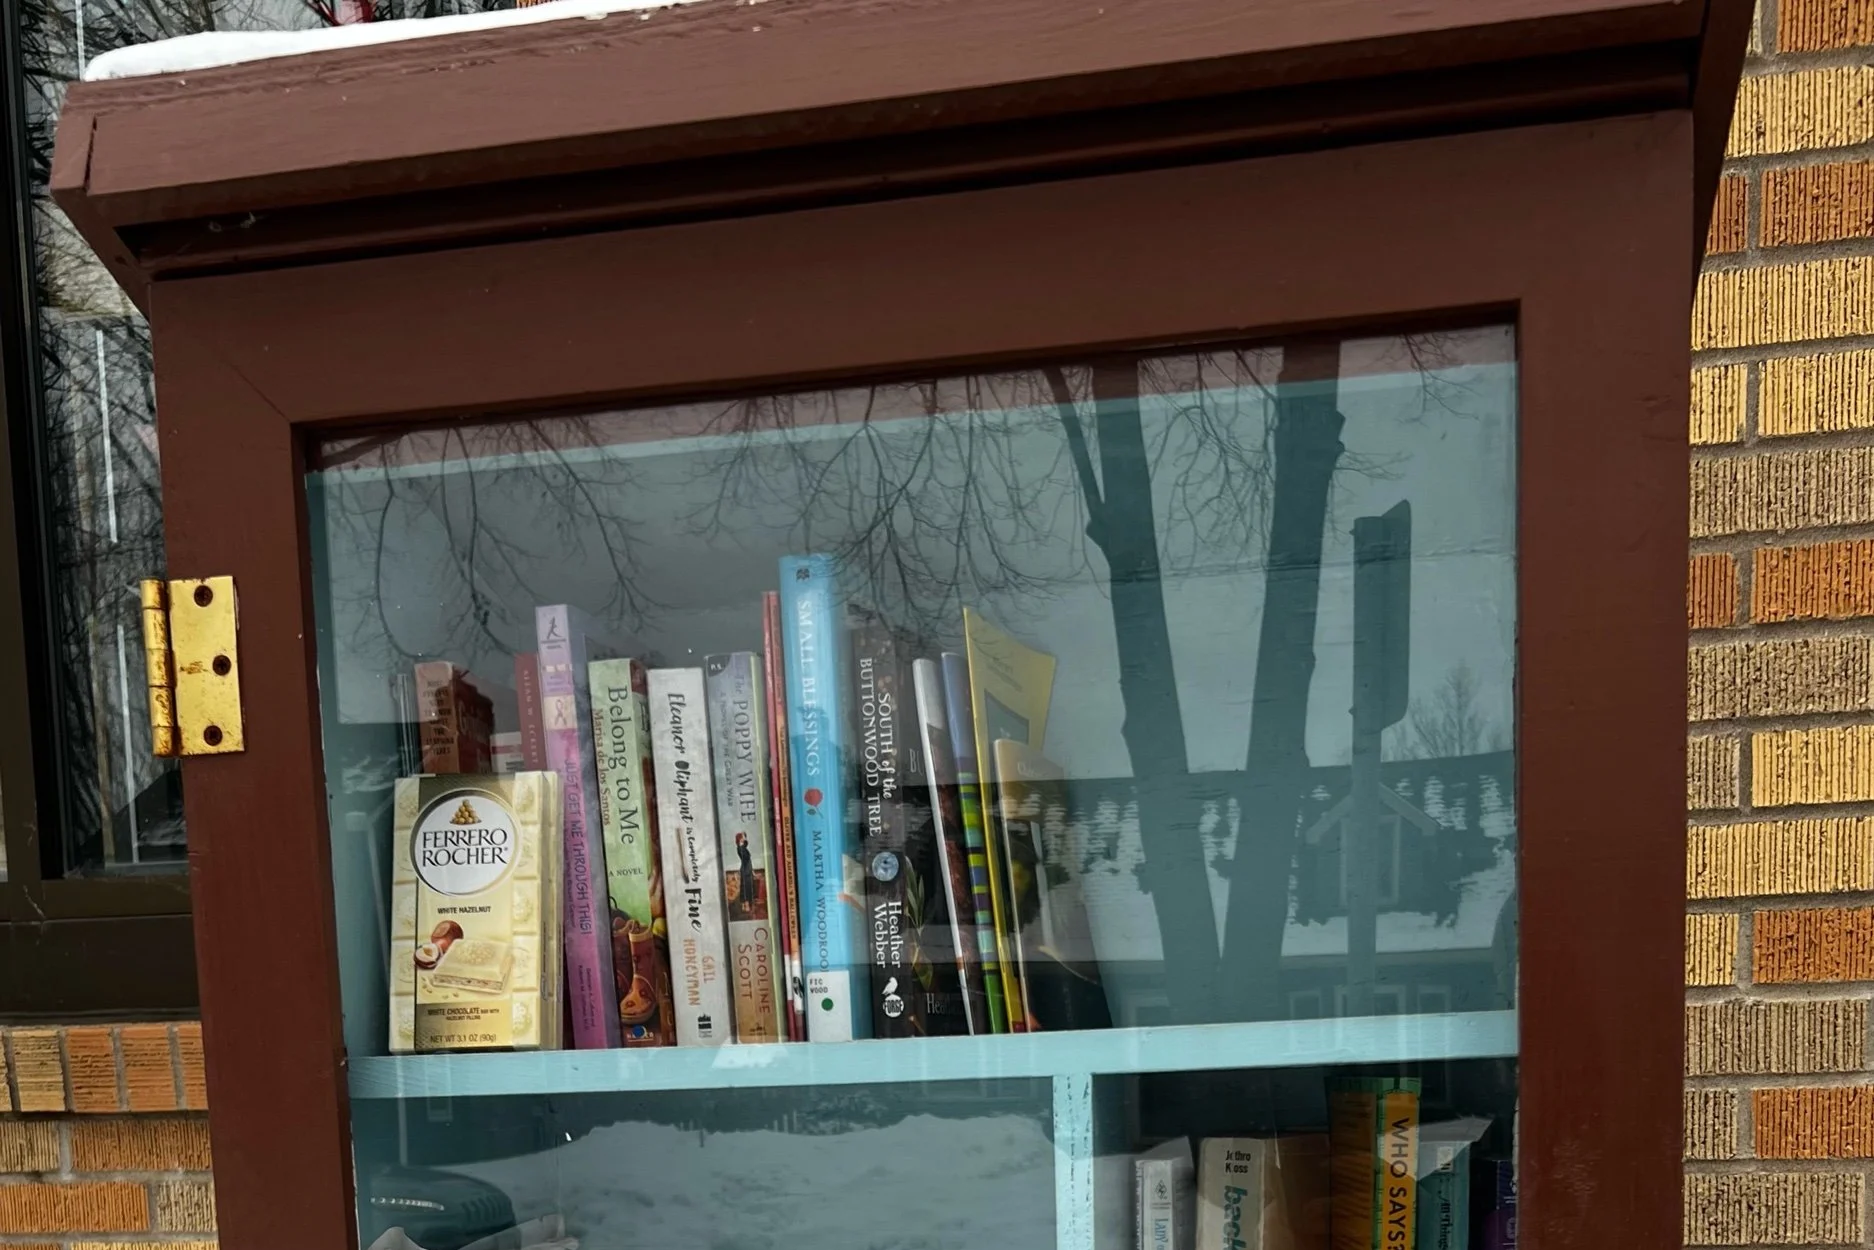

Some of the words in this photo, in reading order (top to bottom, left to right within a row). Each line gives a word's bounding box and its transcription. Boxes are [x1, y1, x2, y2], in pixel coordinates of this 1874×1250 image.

[798, 599, 814, 675] SMALL
[593, 708, 606, 751] Marisa
[607, 686, 632, 770] Belong
[667, 692, 687, 754] Eleanor
[733, 700, 753, 763] POPPY
[802, 677, 820, 777] BLESSINGS
[859, 657, 880, 787] BUTTONWOOD
[878, 691, 893, 755] SOUTH
[565, 759, 579, 790] JUST
[597, 751, 608, 765] de
[599, 768, 609, 785] los
[882, 760, 896, 774] of
[568, 793, 582, 817] GET
[601, 787, 611, 826] Santos
[616, 776, 631, 801] to
[673, 760, 694, 824] Oliphant
[736, 771, 757, 823] WIFE
[882, 777, 897, 800] the
[570, 820, 584, 839] ME
[618, 807, 640, 845] Me
[686, 827, 693, 835] is
[867, 792, 882, 837] TREE
[422, 828, 508, 849] FERRERO
[422, 847, 508, 868] ROCHER
[573, 842, 589, 901] THROUGH
[608, 869, 614, 877] A
[616, 868, 643, 877] NOVEL
[812, 830, 825, 892] MARTHA
[437, 906, 458, 915] WHITE
[459, 905, 492, 914] HAZELNUT
[684, 888, 702, 934] Fine
[817, 897, 830, 972] WOODROO
[874, 902, 889, 969] Webber
[888, 901, 904, 969] Heather
[683, 938, 701, 1007] HONEYMAN
[701, 955, 716, 984] GAIL
[738, 943, 752, 1000] SCOTT
[753, 927, 771, 1014] CAROLINE
[809, 978, 823, 986] FIC
[809, 986, 829, 994] WOOD
[430, 1035, 443, 1043] NET
[444, 1034, 456, 1043] WT
[457, 1034, 467, 1043] 3.1
[468, 1034, 479, 1042] OZ
[1225, 1162, 1249, 1174] Koss
[1389, 1117, 1410, 1179] WHO
[1154, 1218, 1169, 1243] LADY
